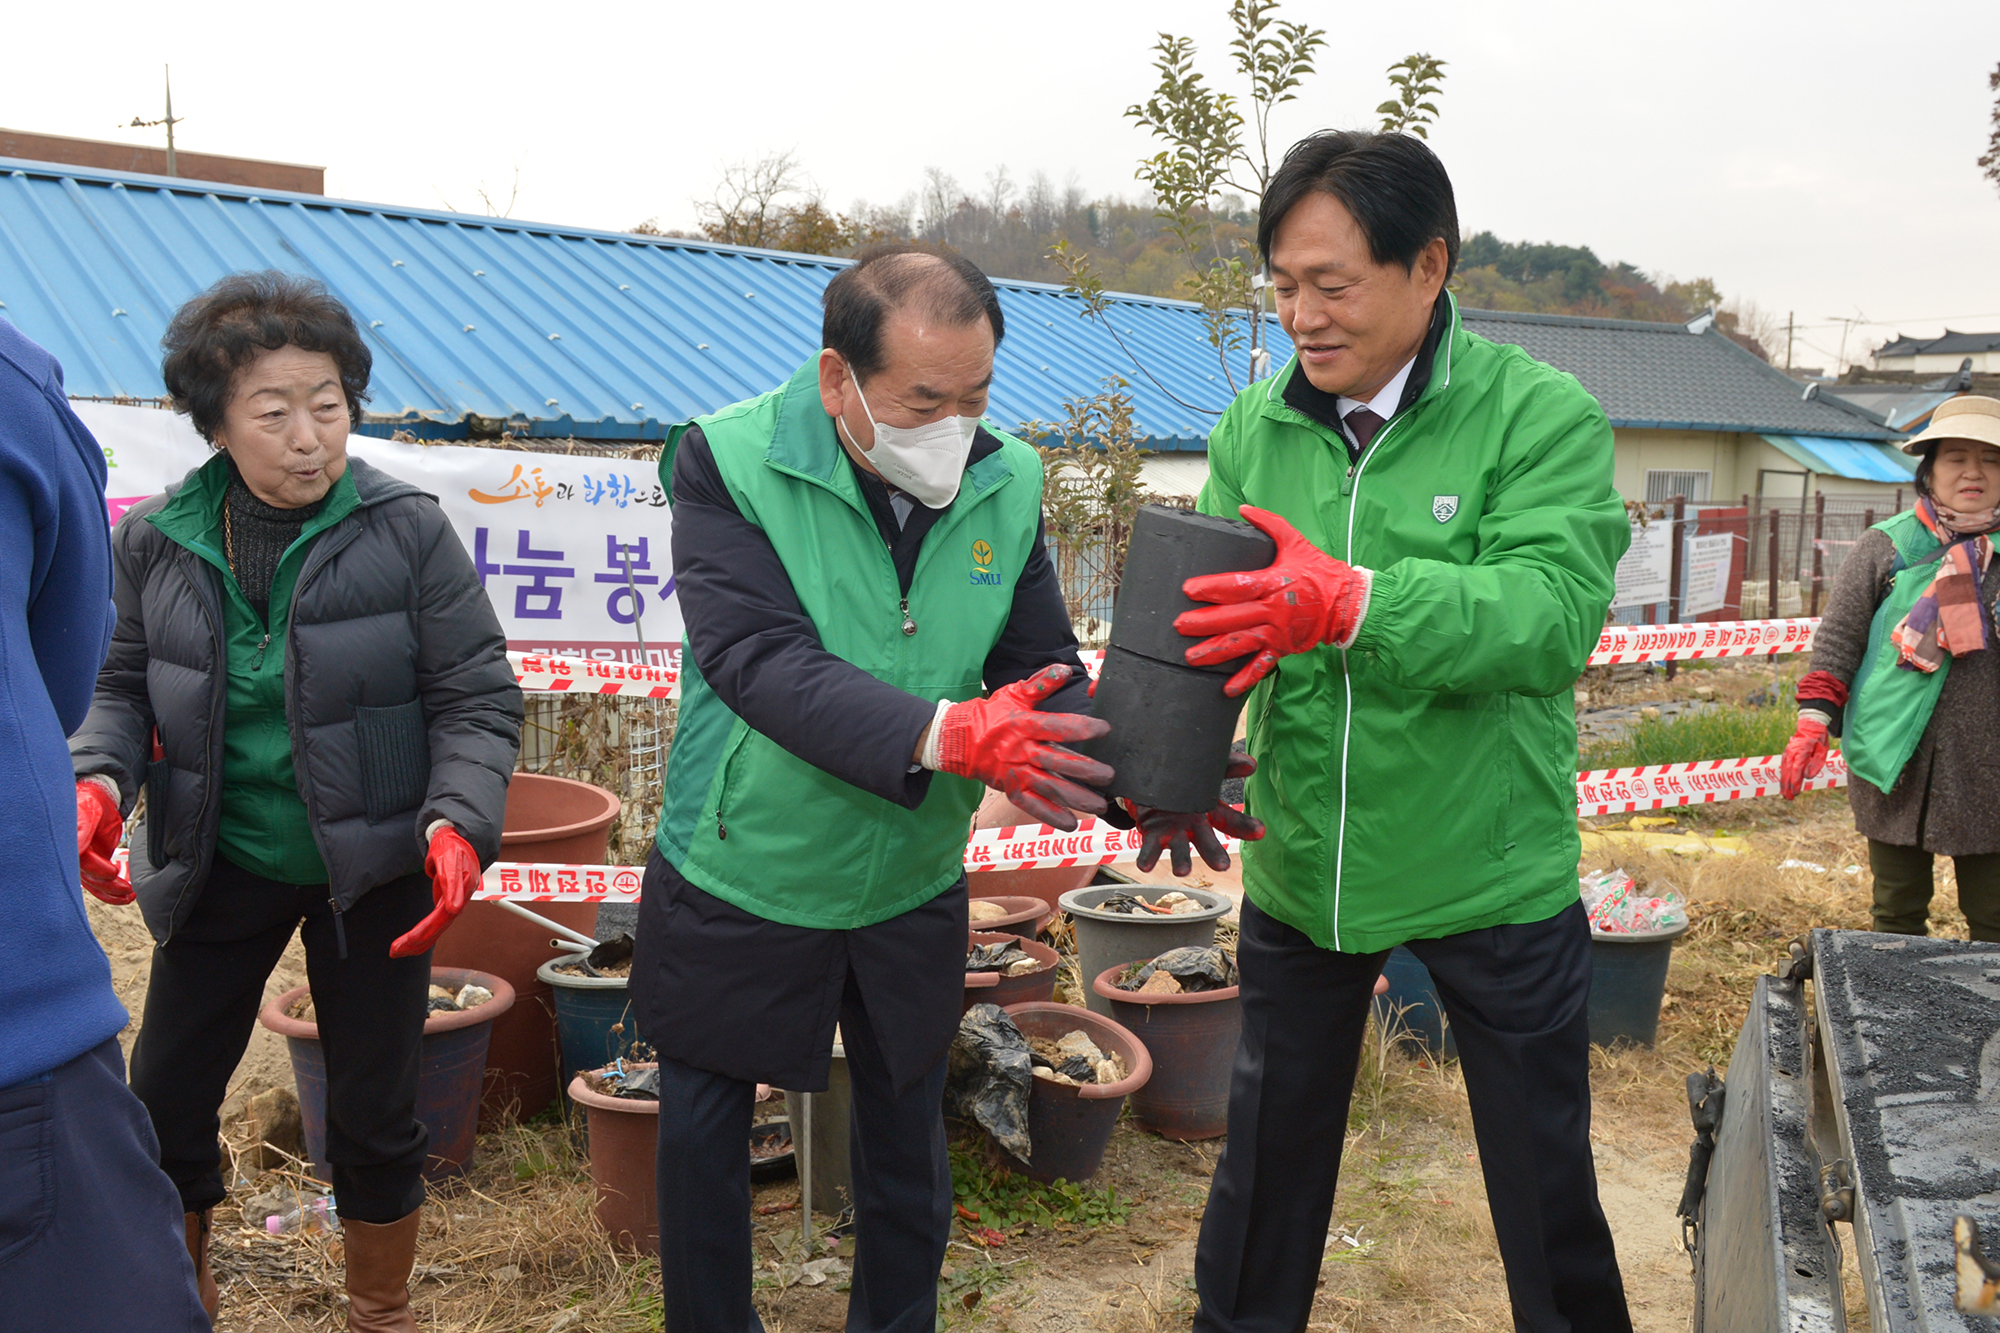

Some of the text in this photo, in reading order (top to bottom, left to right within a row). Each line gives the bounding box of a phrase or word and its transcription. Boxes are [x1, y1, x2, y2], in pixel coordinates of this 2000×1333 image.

[468, 464, 667, 509] 소통과 화합으로
[594, 534, 676, 625] 봉
[969, 571, 1003, 586] SMU
[1596, 624, 1812, 653] 위험 안전제일 DANGER! 위험
[1653, 775, 1684, 796] 위험
[1686, 770, 1749, 792] DANGER!
[1749, 766, 1782, 786] 제일
[962, 829, 1142, 864] 제일 DANGER! 위
[500, 868, 608, 894] 안전제일
